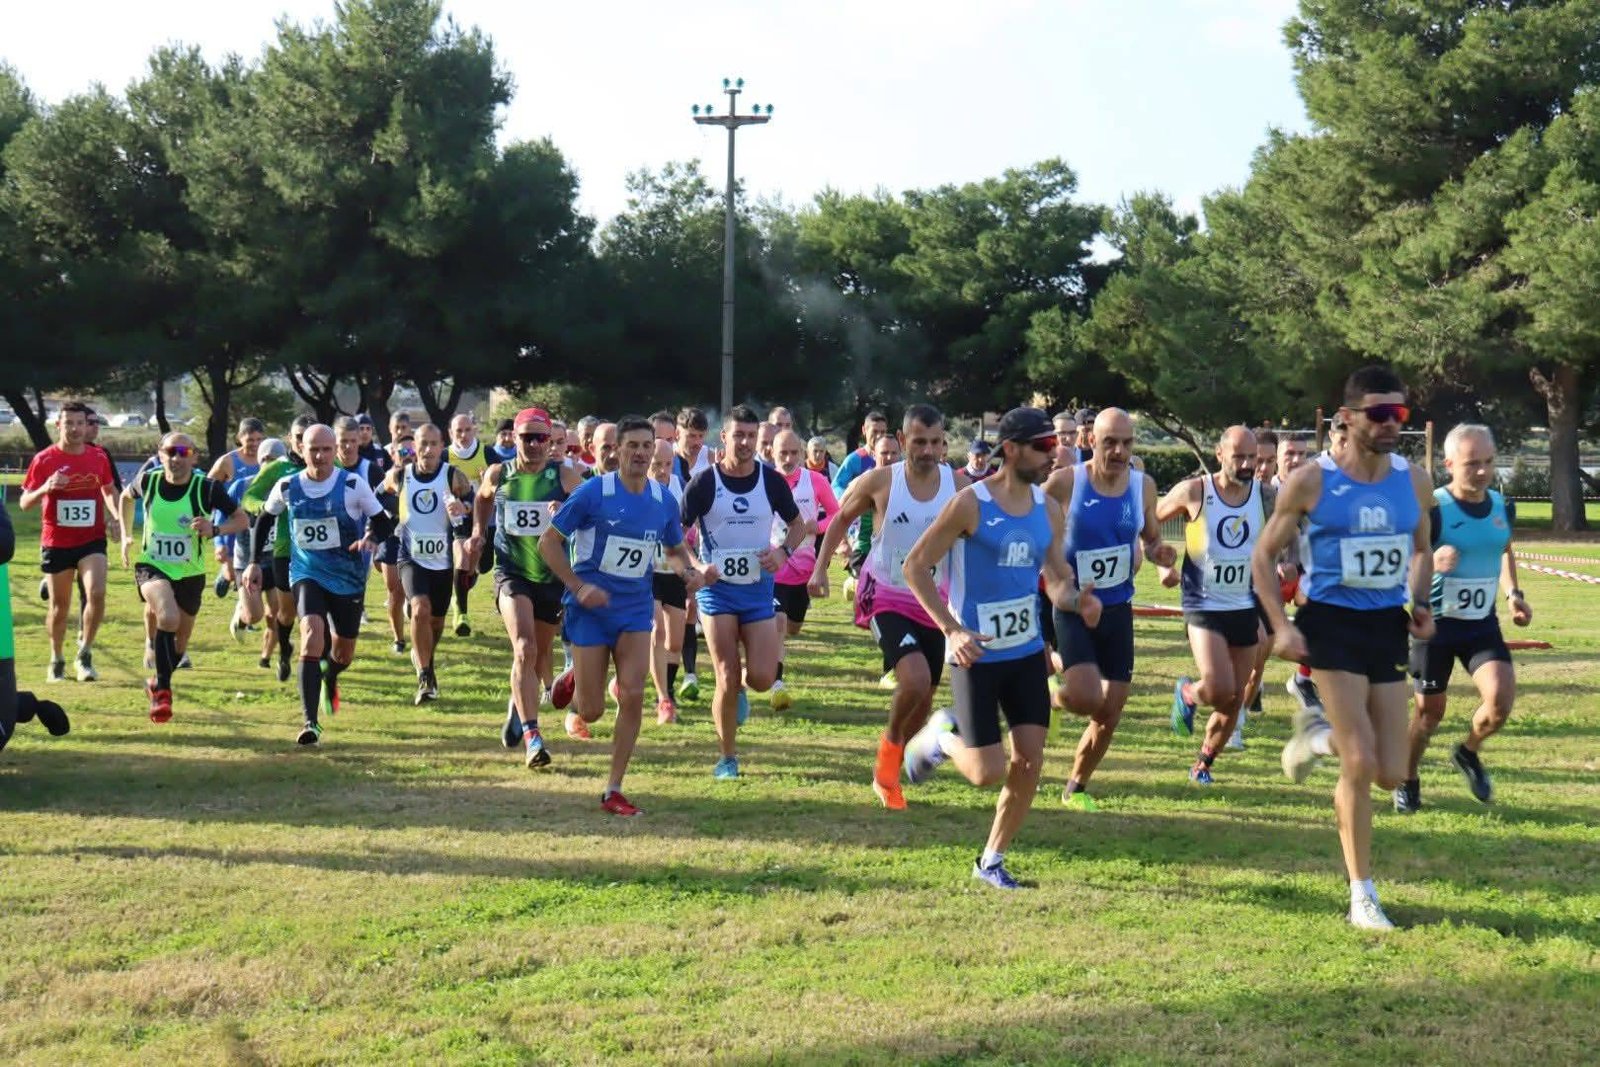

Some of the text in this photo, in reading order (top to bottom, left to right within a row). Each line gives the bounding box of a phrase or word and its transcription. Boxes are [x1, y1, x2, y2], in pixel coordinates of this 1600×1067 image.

[63, 506, 90, 521] 135
[516, 510, 541, 528] 83
[304, 524, 328, 543] 98
[155, 539, 186, 557] 110
[417, 539, 445, 554] 100
[616, 546, 643, 569] 79
[723, 557, 749, 577] 88
[1353, 548, 1402, 578] 129
[1091, 556, 1118, 581] 97
[1213, 565, 1245, 584] 101
[1457, 588, 1486, 609] 90
[990, 608, 1030, 639] 128
